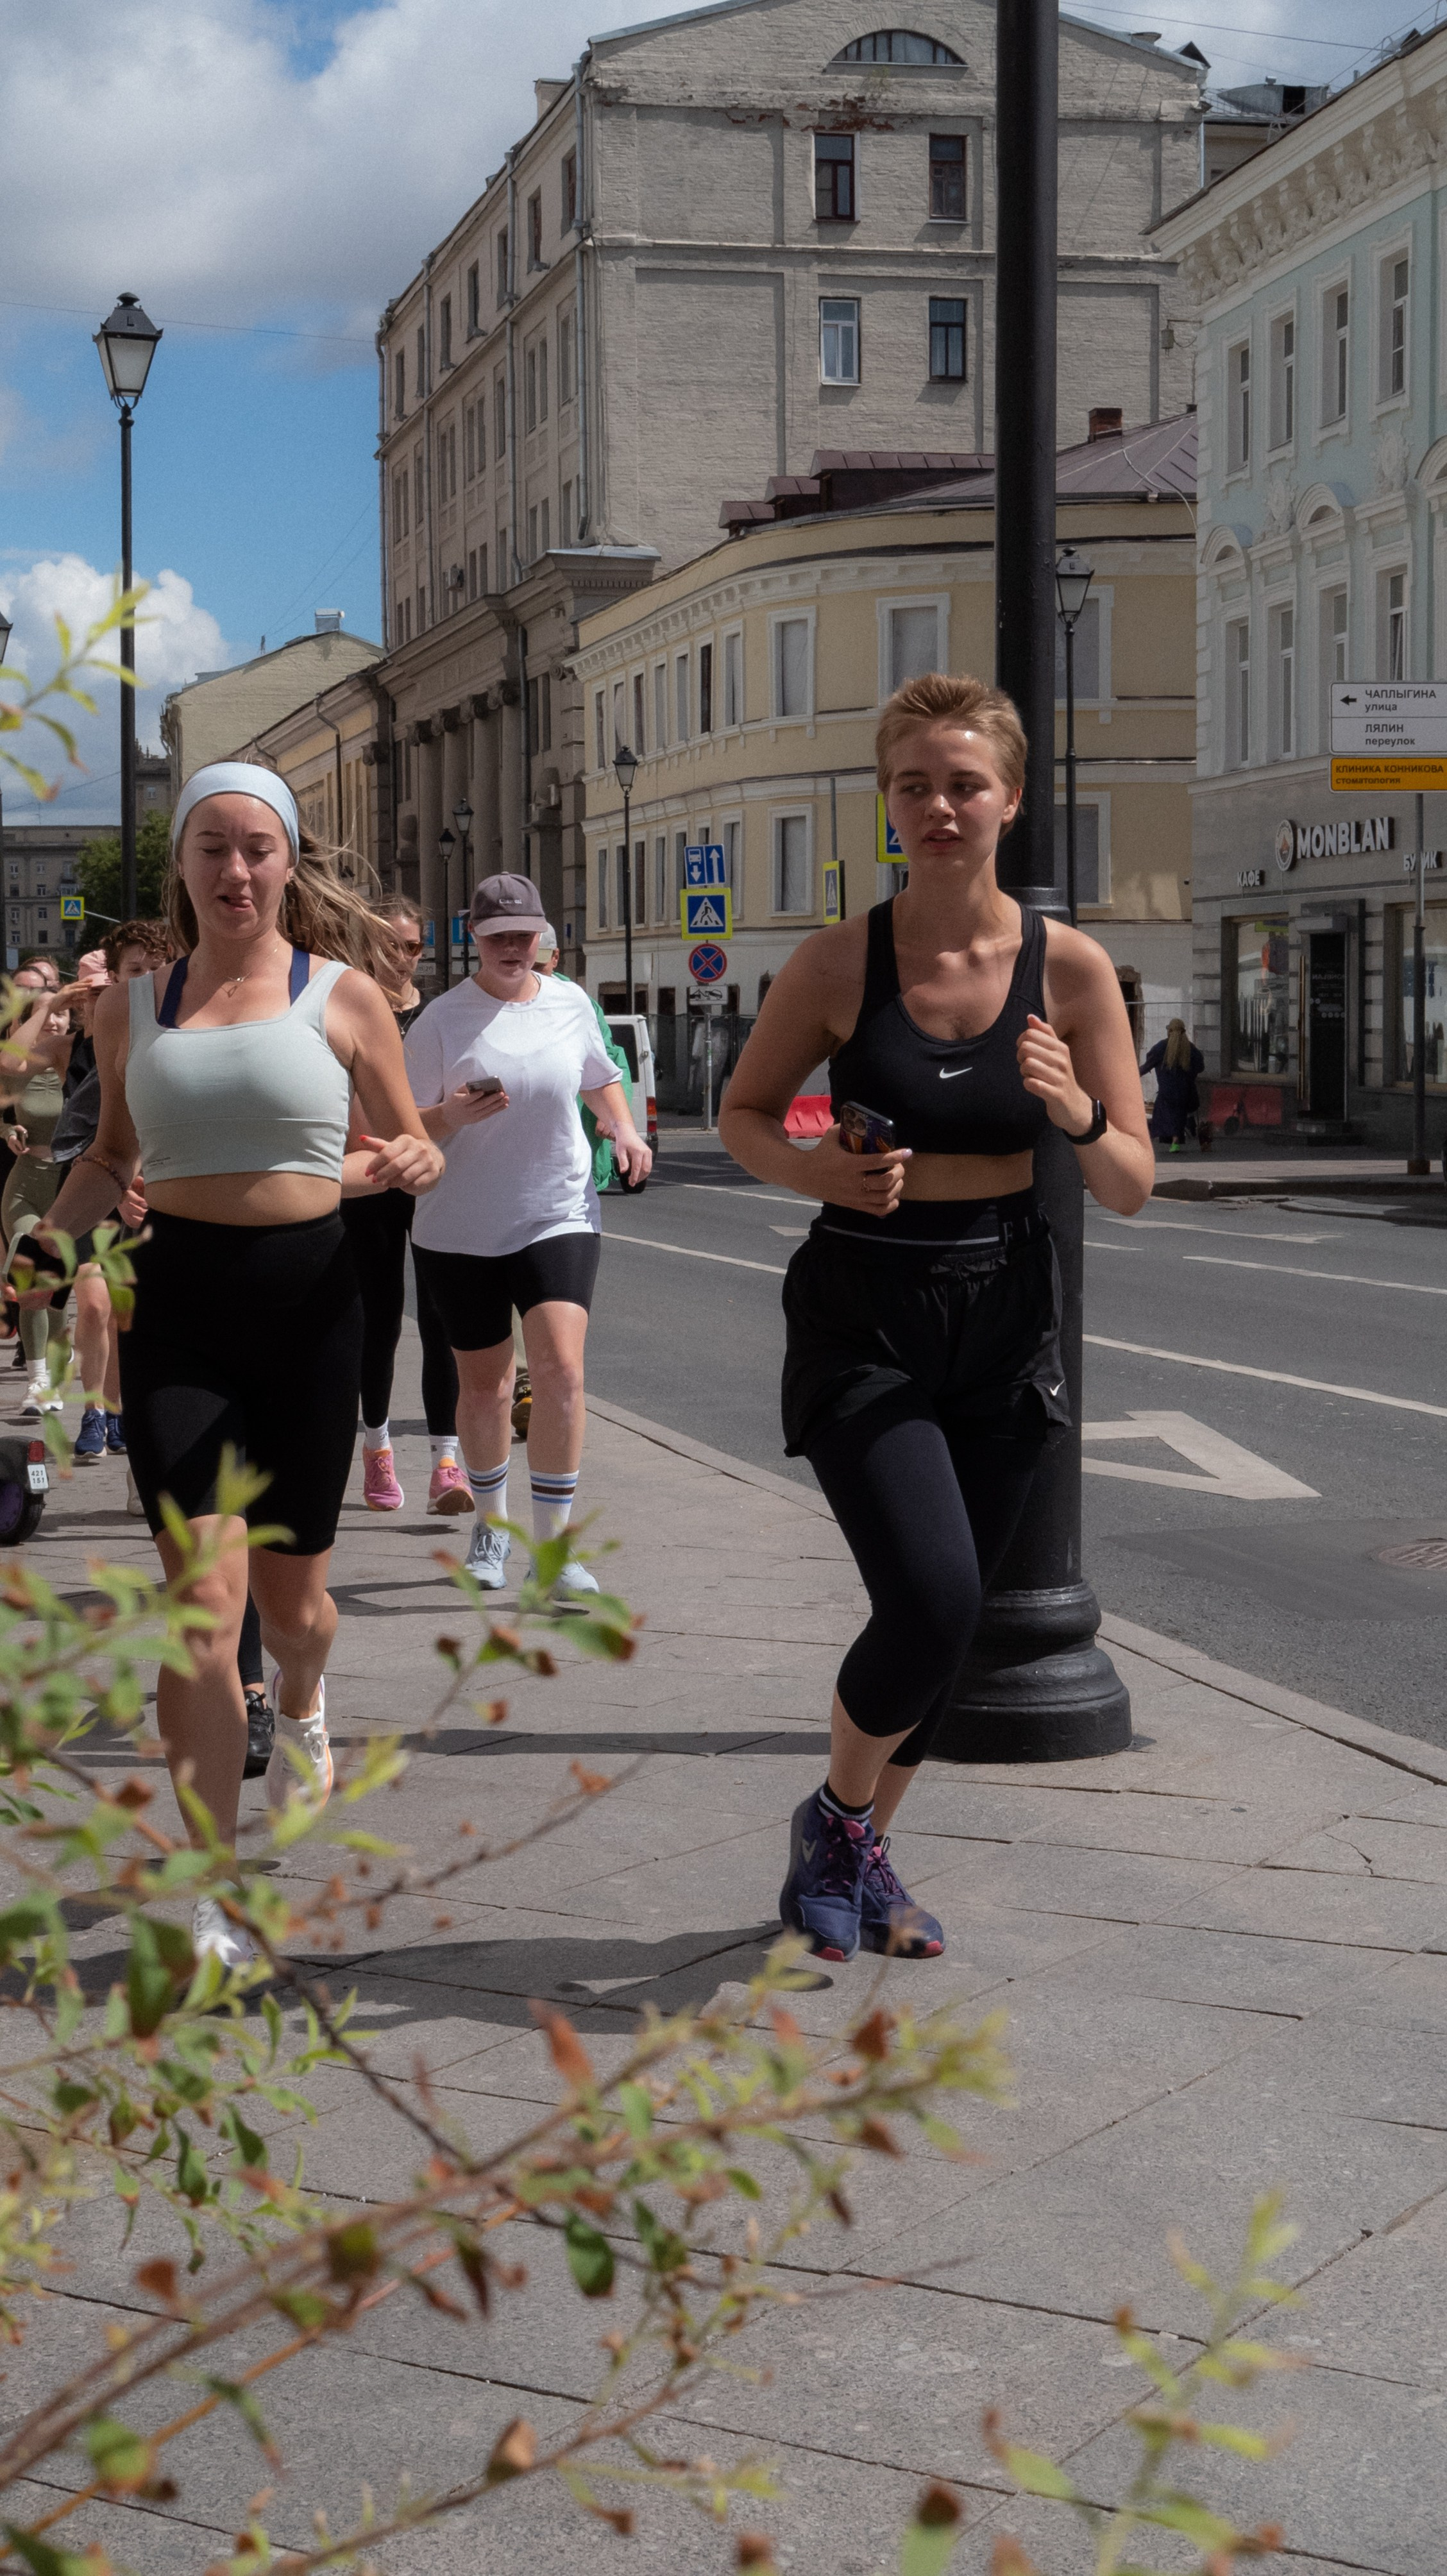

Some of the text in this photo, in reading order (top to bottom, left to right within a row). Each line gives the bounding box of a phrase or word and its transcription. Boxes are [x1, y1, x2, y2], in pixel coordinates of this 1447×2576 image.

[1365, 690, 1437, 699] ЧАПЛЫГИНА
[1365, 703, 1398, 713] улица
[1365, 724, 1404, 733] ЛЯЛИН
[1365, 738, 1416, 747] переулок
[1384, 765, 1444, 773] КОННИКОВА
[1297, 817, 1390, 859] MONBLAN
[1403, 851, 1437, 871] БУИК
[1237, 870, 1260, 888] КАФЕ
